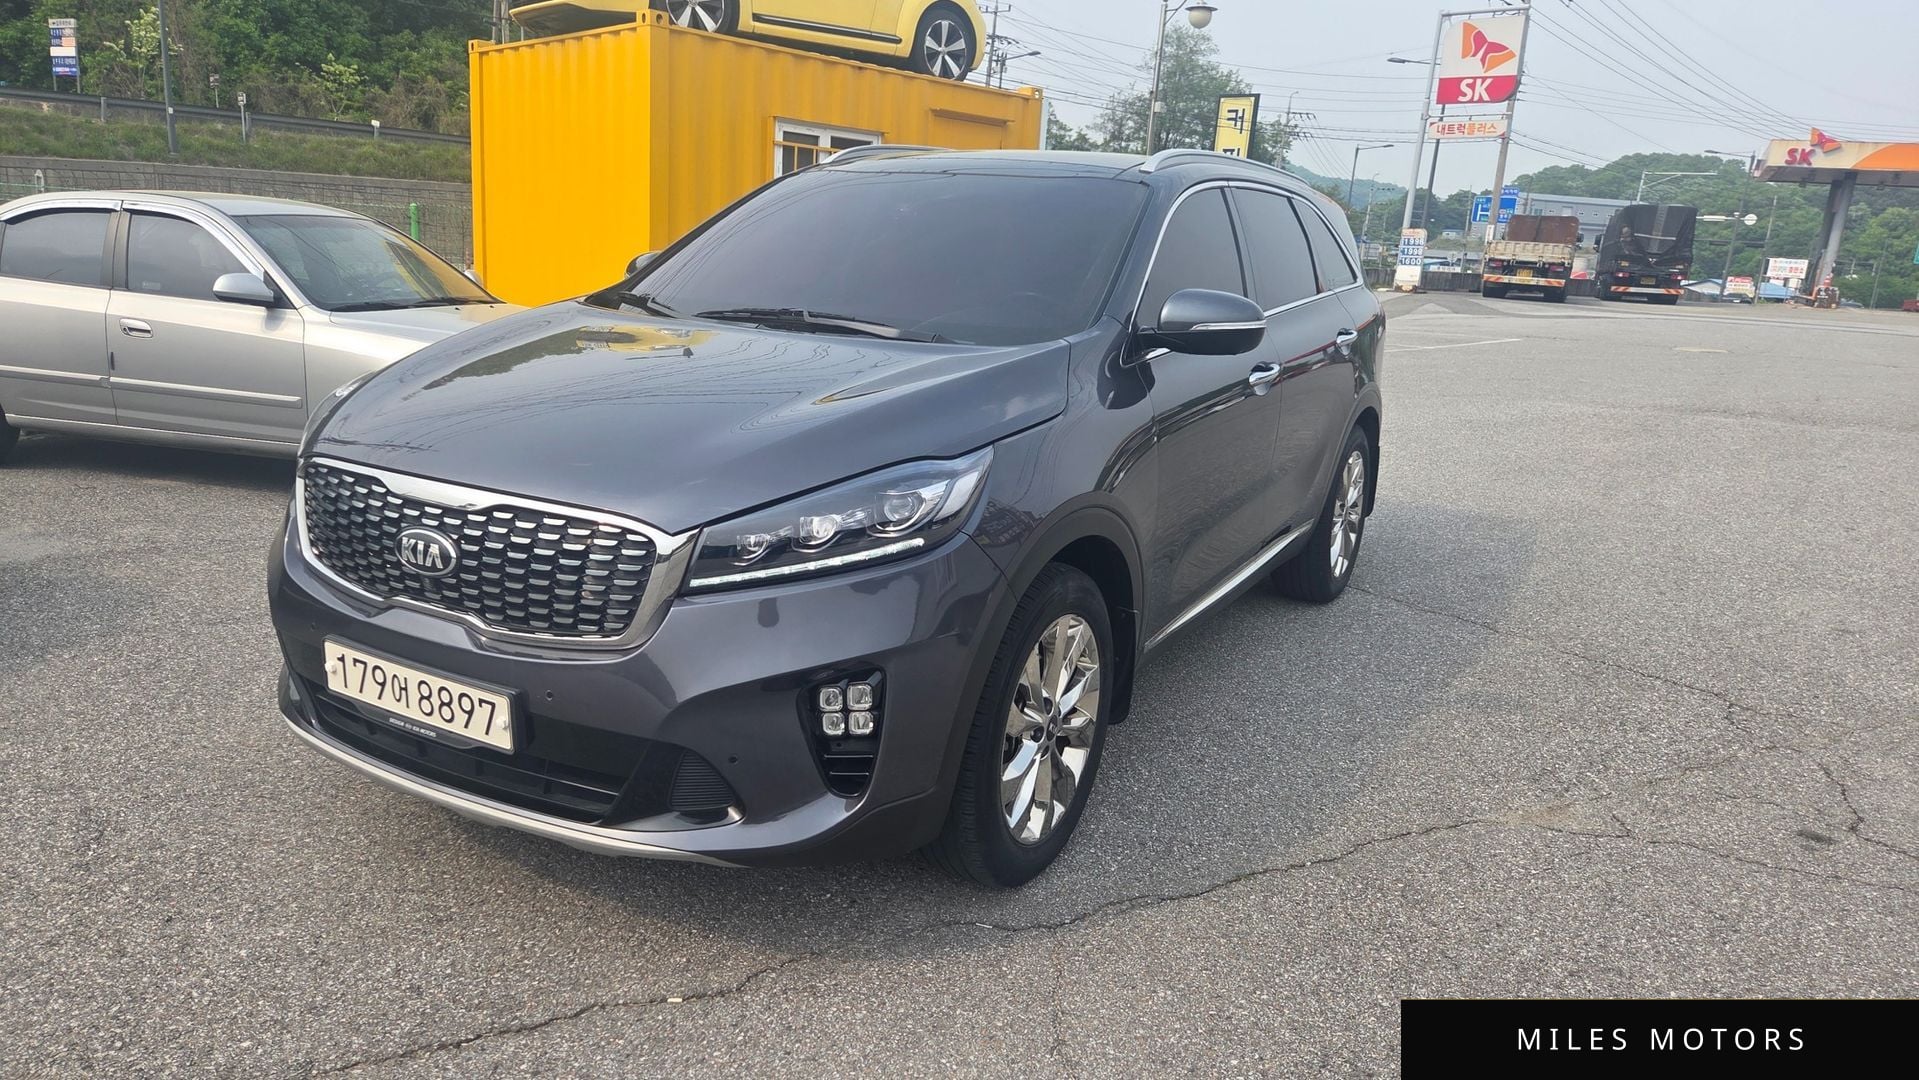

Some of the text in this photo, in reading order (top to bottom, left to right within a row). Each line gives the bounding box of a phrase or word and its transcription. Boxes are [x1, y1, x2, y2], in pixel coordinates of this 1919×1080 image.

[1457, 78, 1494, 102] SK
[1436, 122, 1498, 136] 내트럭플러스
[1784, 147, 1816, 166] SK
[1401, 257, 1422, 265] 1600
[402, 536, 444, 569] KIA
[336, 653, 497, 736] 179어 8897
